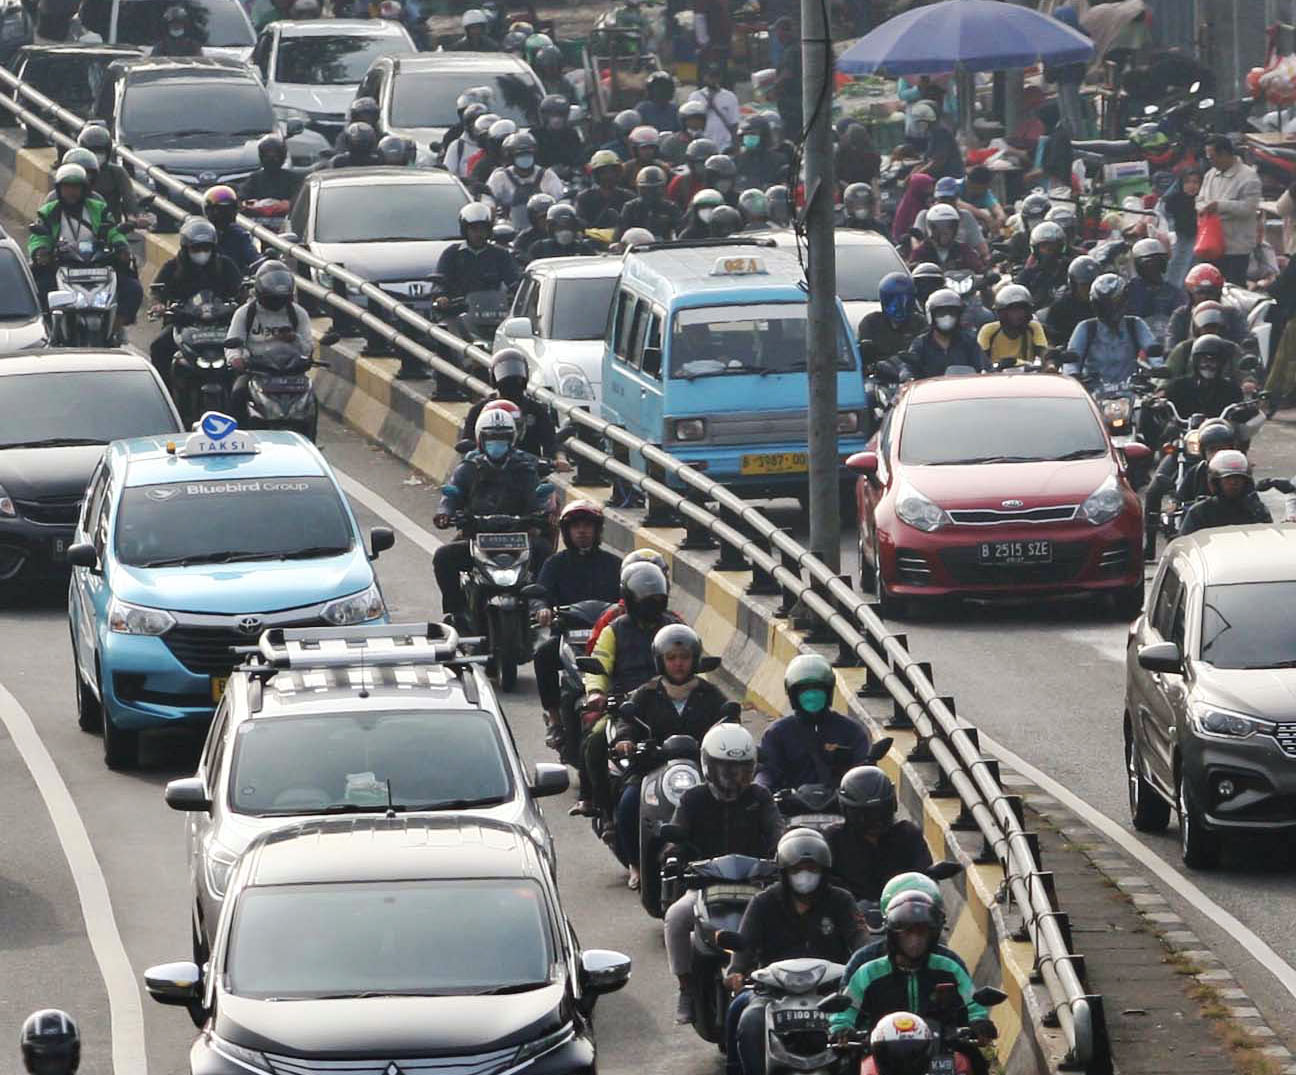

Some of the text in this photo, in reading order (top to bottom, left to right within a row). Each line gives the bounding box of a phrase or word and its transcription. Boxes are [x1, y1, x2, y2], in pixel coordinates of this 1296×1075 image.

[198, 442, 245, 452] TAKSI
[186, 480, 309, 496] Bluebird Group
[982, 541, 1048, 557] B 2515 SZE
